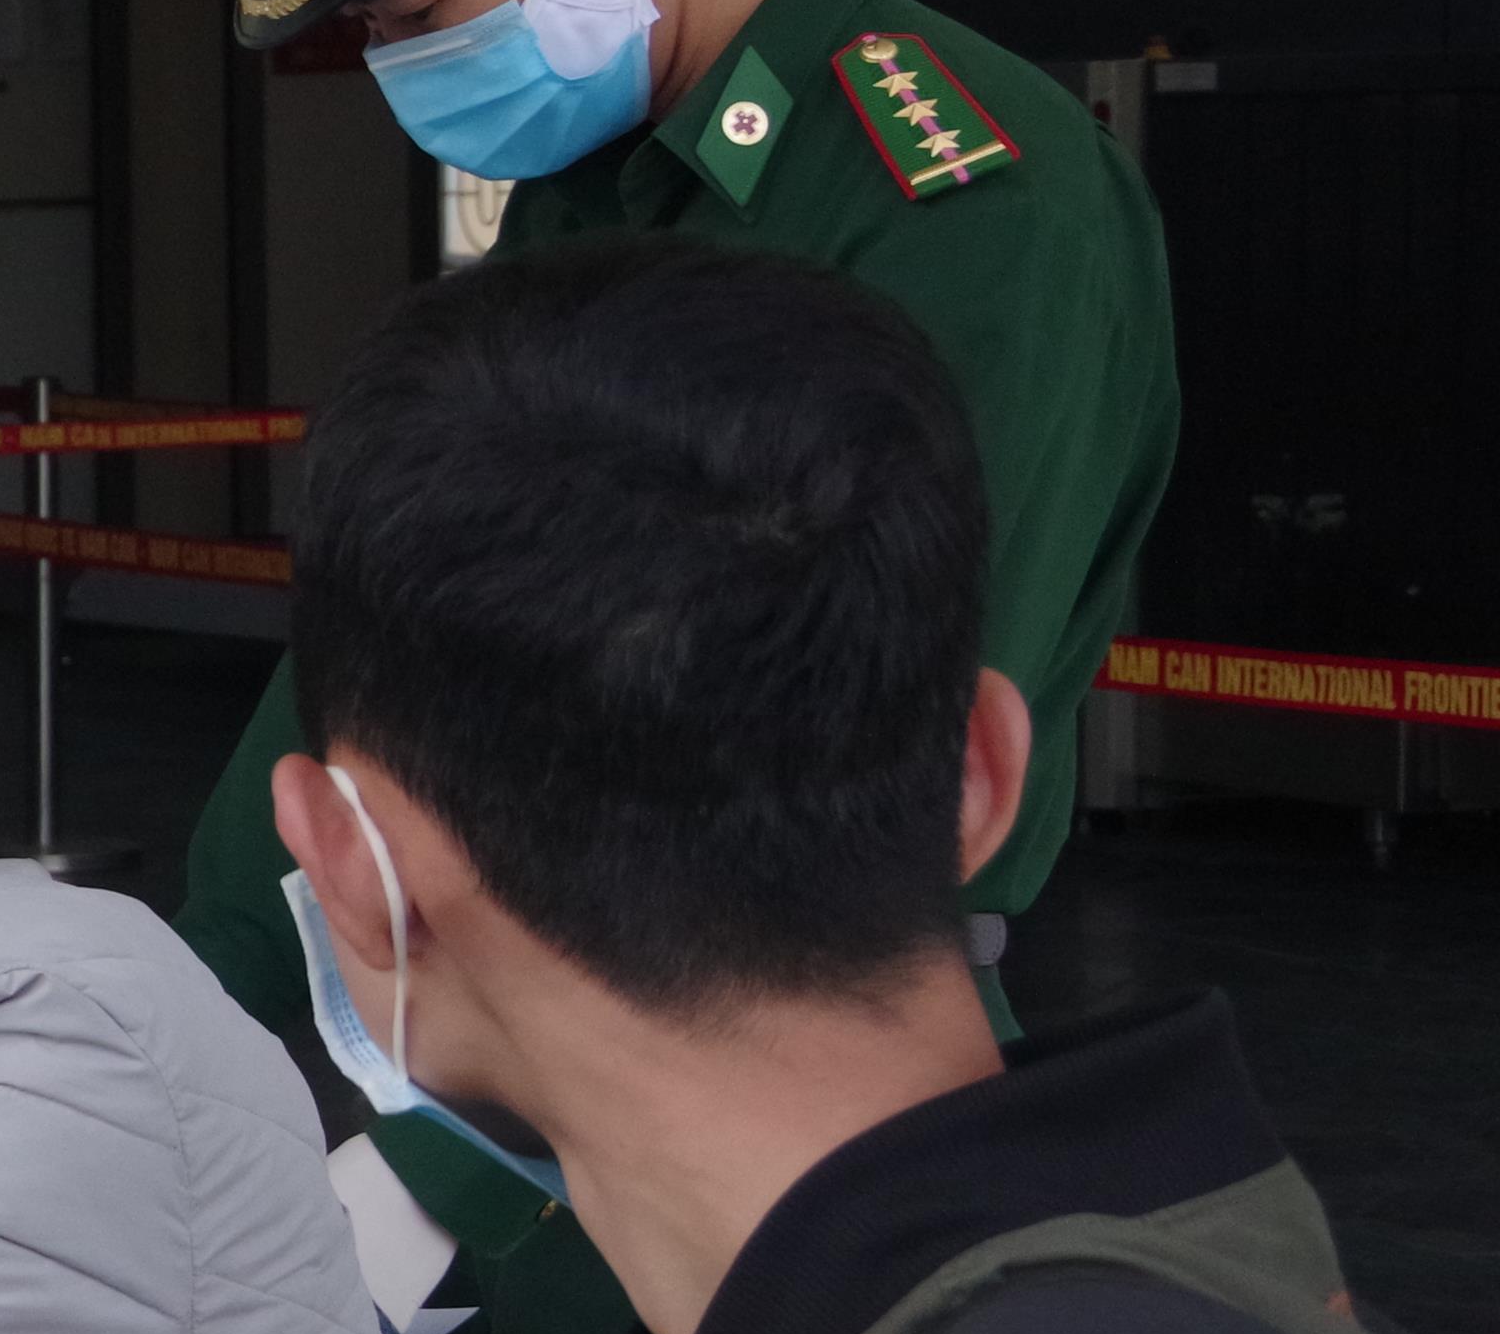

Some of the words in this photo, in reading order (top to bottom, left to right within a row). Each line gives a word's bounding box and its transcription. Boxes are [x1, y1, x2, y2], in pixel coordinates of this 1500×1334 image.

[1108, 642, 1160, 686] NAM
[1165, 651, 1211, 693] CAN
[1216, 655, 1397, 710] INTERNATIONAL
